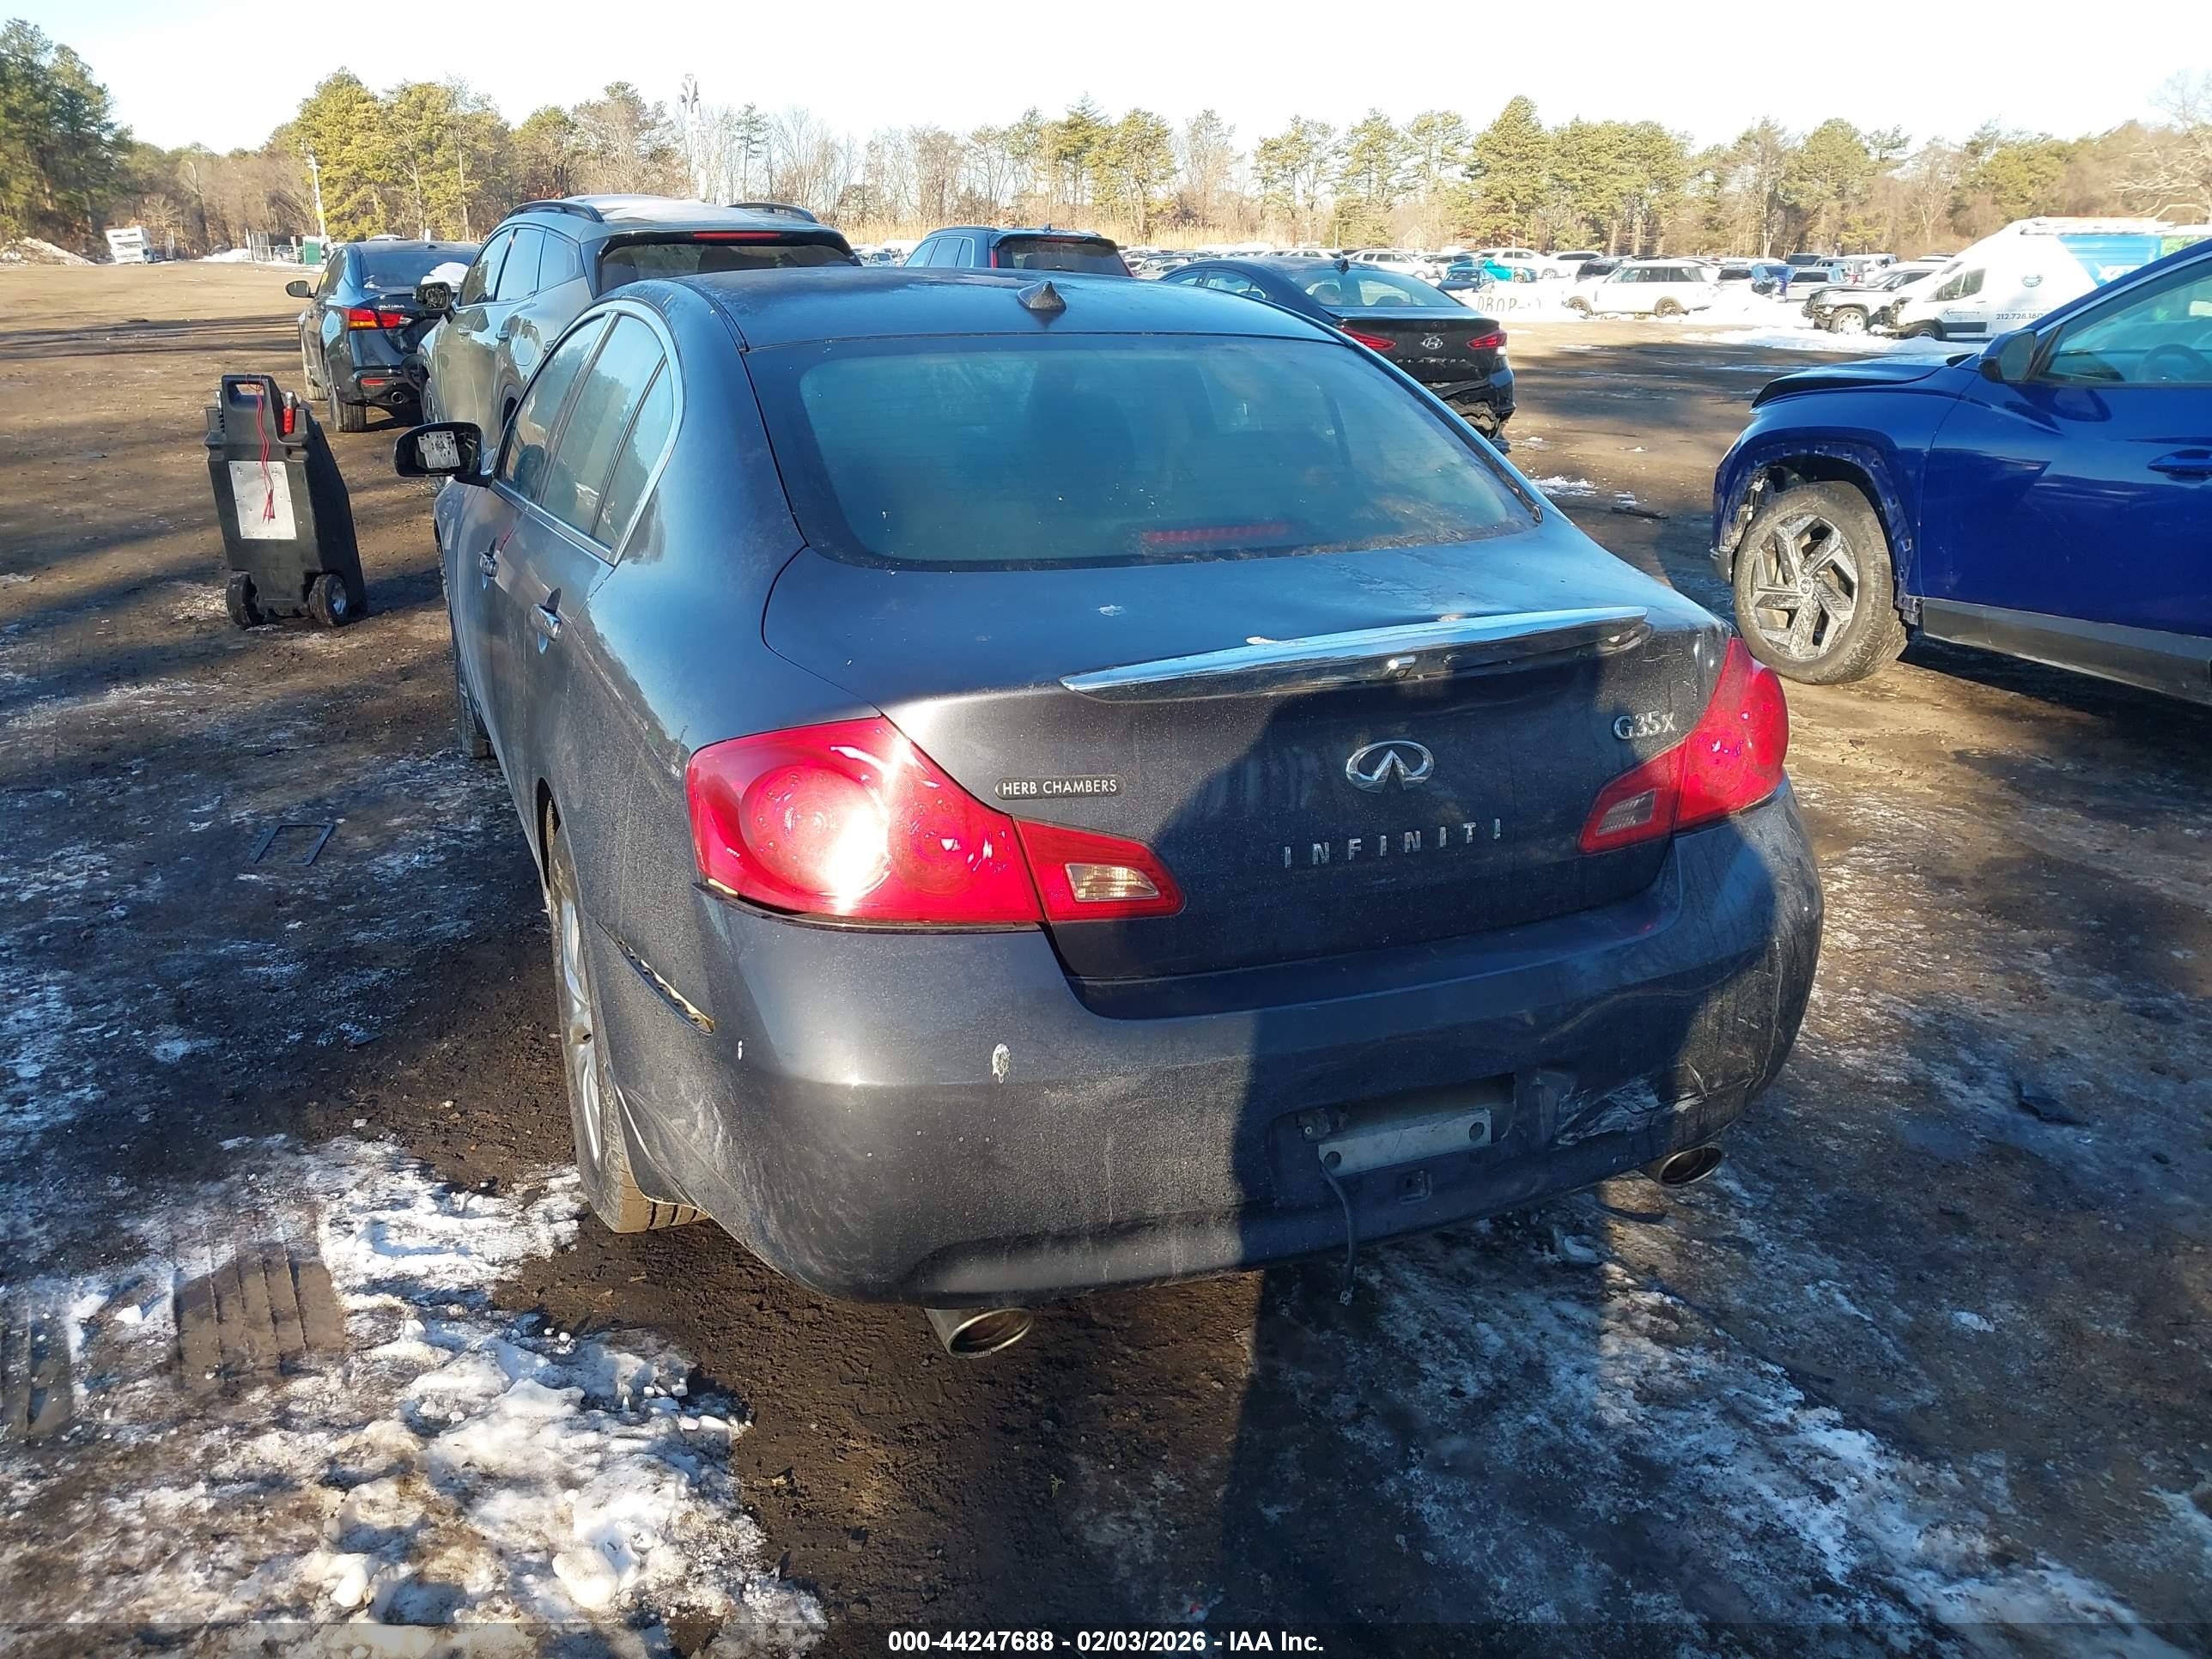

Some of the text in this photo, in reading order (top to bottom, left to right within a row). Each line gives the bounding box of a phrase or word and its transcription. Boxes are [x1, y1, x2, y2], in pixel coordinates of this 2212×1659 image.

[1002, 779, 1117, 795] HERB CHAMBERS
[1284, 818, 1502, 868] INFINITI
